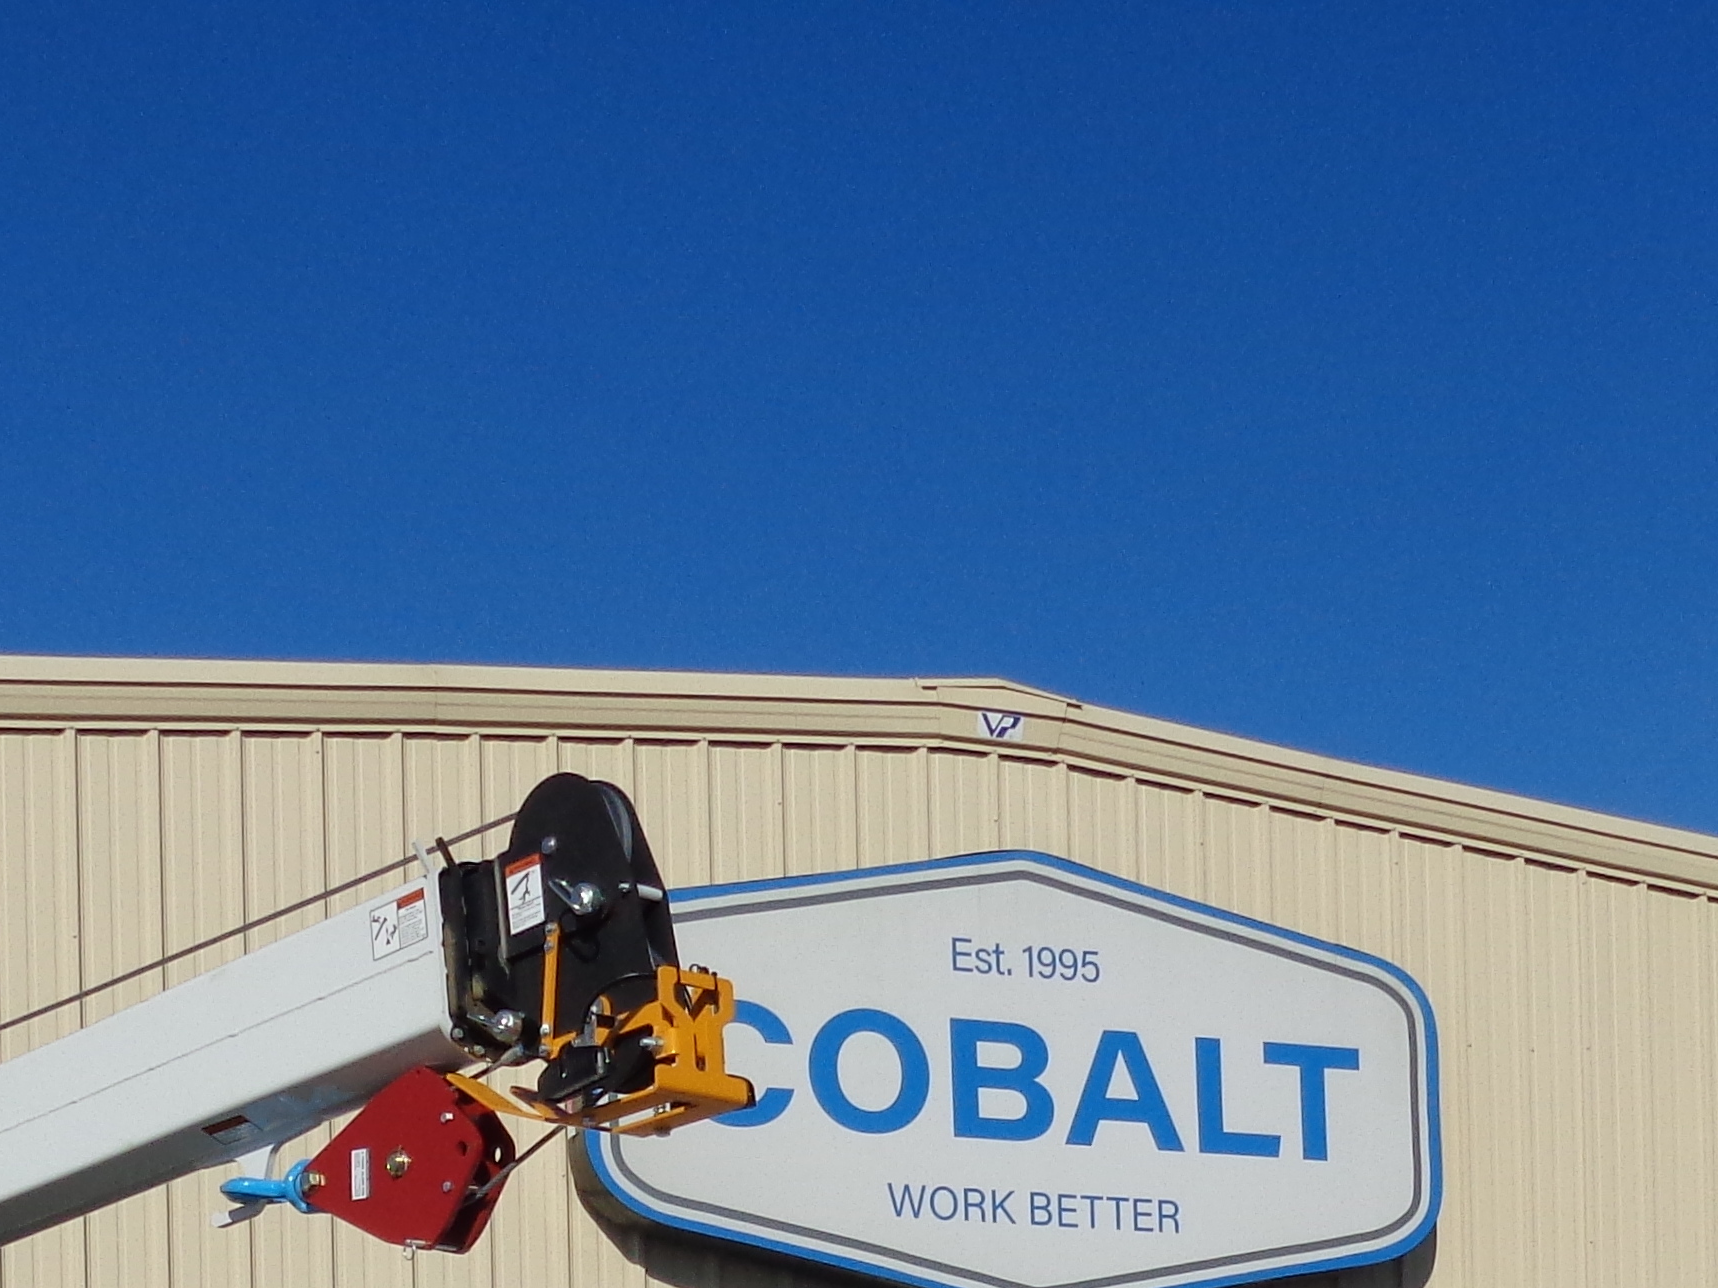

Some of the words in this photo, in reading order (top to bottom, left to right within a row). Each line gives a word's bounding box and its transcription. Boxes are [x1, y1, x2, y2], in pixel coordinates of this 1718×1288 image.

[951, 936, 1013, 978] Est.
[1024, 946, 1101, 985] 1995
[705, 1000, 1360, 1162] COBALT
[887, 1181, 1017, 1226] WORK
[1028, 1192, 1181, 1235] BETTER
